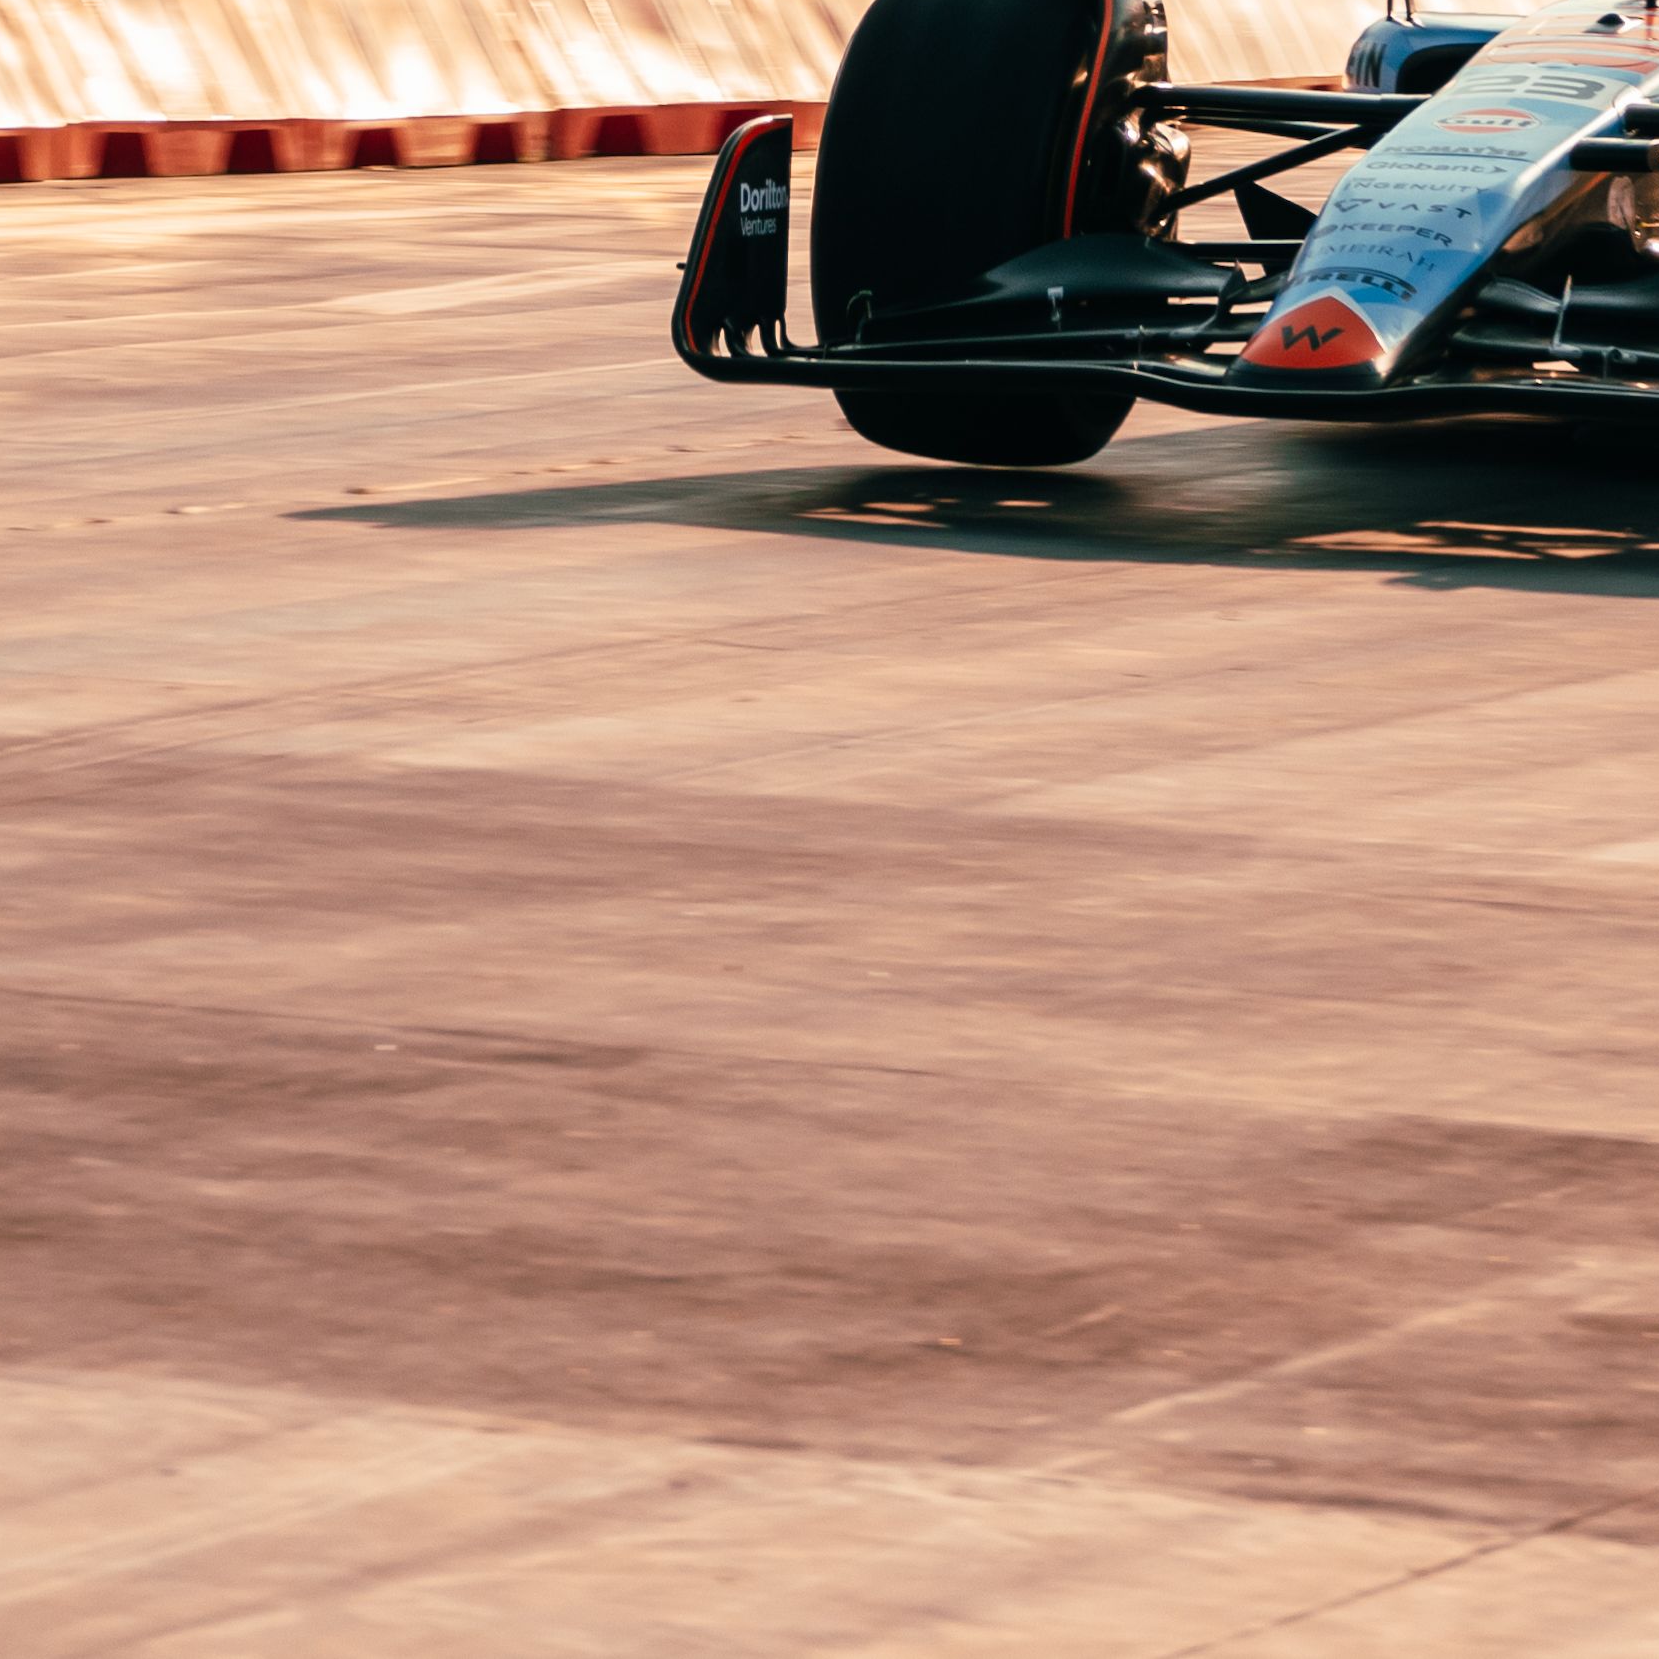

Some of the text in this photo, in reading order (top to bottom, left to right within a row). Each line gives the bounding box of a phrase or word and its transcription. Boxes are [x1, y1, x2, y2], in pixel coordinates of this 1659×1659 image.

[1444, 74, 1605, 100] 23
[1438, 115, 1533, 128] Gulf
[1383, 145, 1528, 157] KOMATSU
[1366, 161, 1485, 174] Globant
[1343, 177, 1490, 194] INGENUITY
[741, 178, 787, 213] Dorilton
[1378, 201, 1472, 219] VAST
[741, 216, 777, 237] Ventures
[1341, 222, 1453, 247] KEEPER
